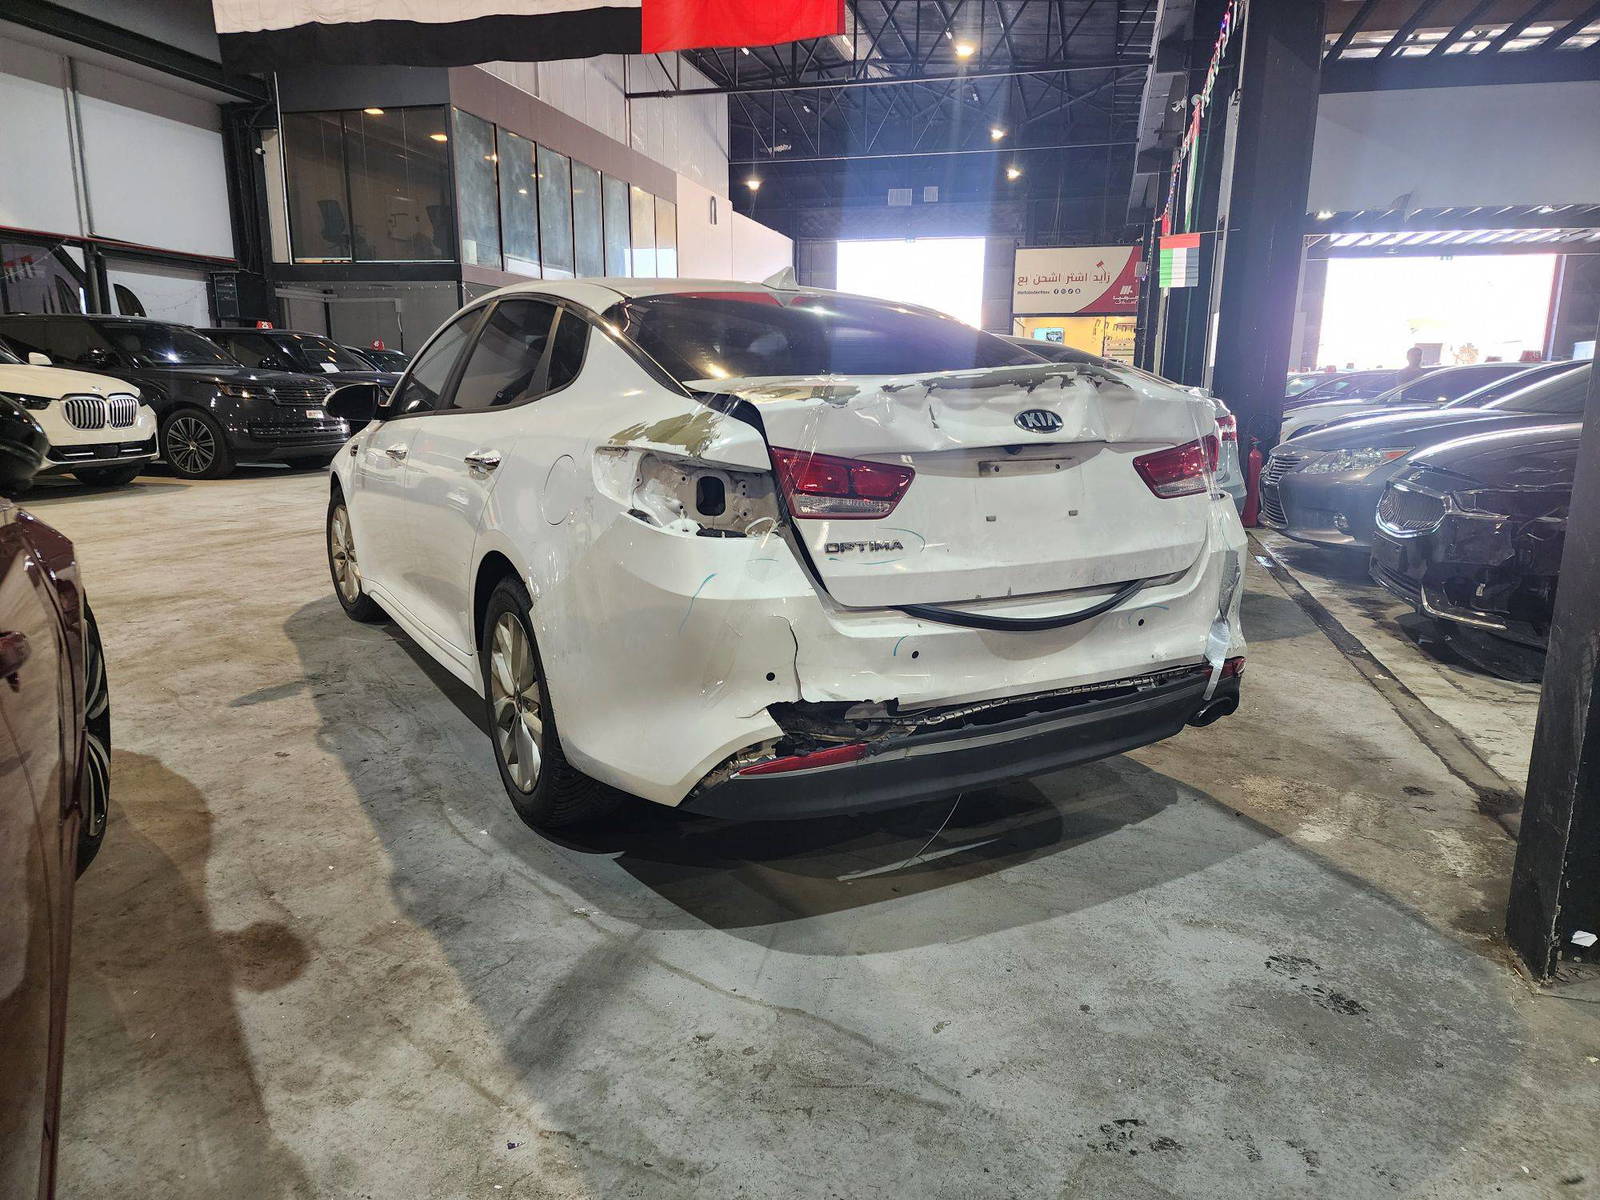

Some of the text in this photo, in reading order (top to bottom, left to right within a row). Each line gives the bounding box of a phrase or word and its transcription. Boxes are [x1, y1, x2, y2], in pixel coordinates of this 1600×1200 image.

[1017, 275, 1028, 286] بع
[1033, 272, 1061, 285] اشحن
[1066, 272, 1088, 284] اشتر
[1022, 412, 1062, 427] KIA
[824, 541, 904, 553] OPTIMA
